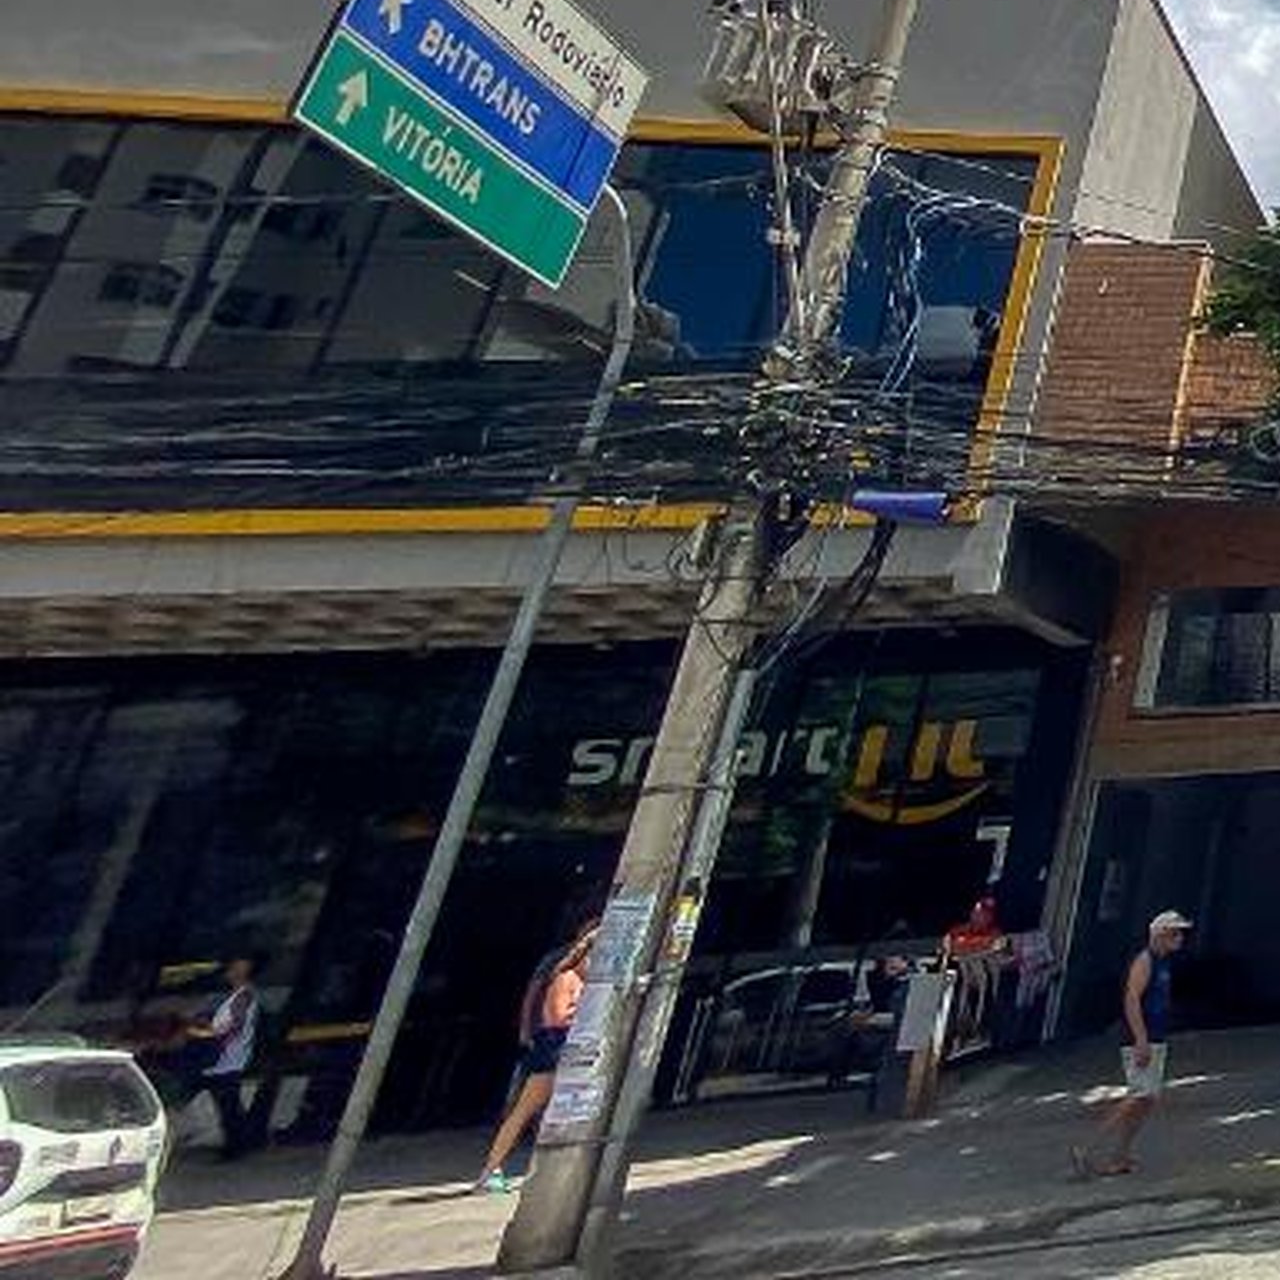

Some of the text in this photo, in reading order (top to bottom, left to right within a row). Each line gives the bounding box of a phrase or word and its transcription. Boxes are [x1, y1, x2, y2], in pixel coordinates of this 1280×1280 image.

[417, 19, 543, 138] BHTRANS
[382, 105, 486, 206] VITÓRIA
[566, 726, 839, 786] sart
